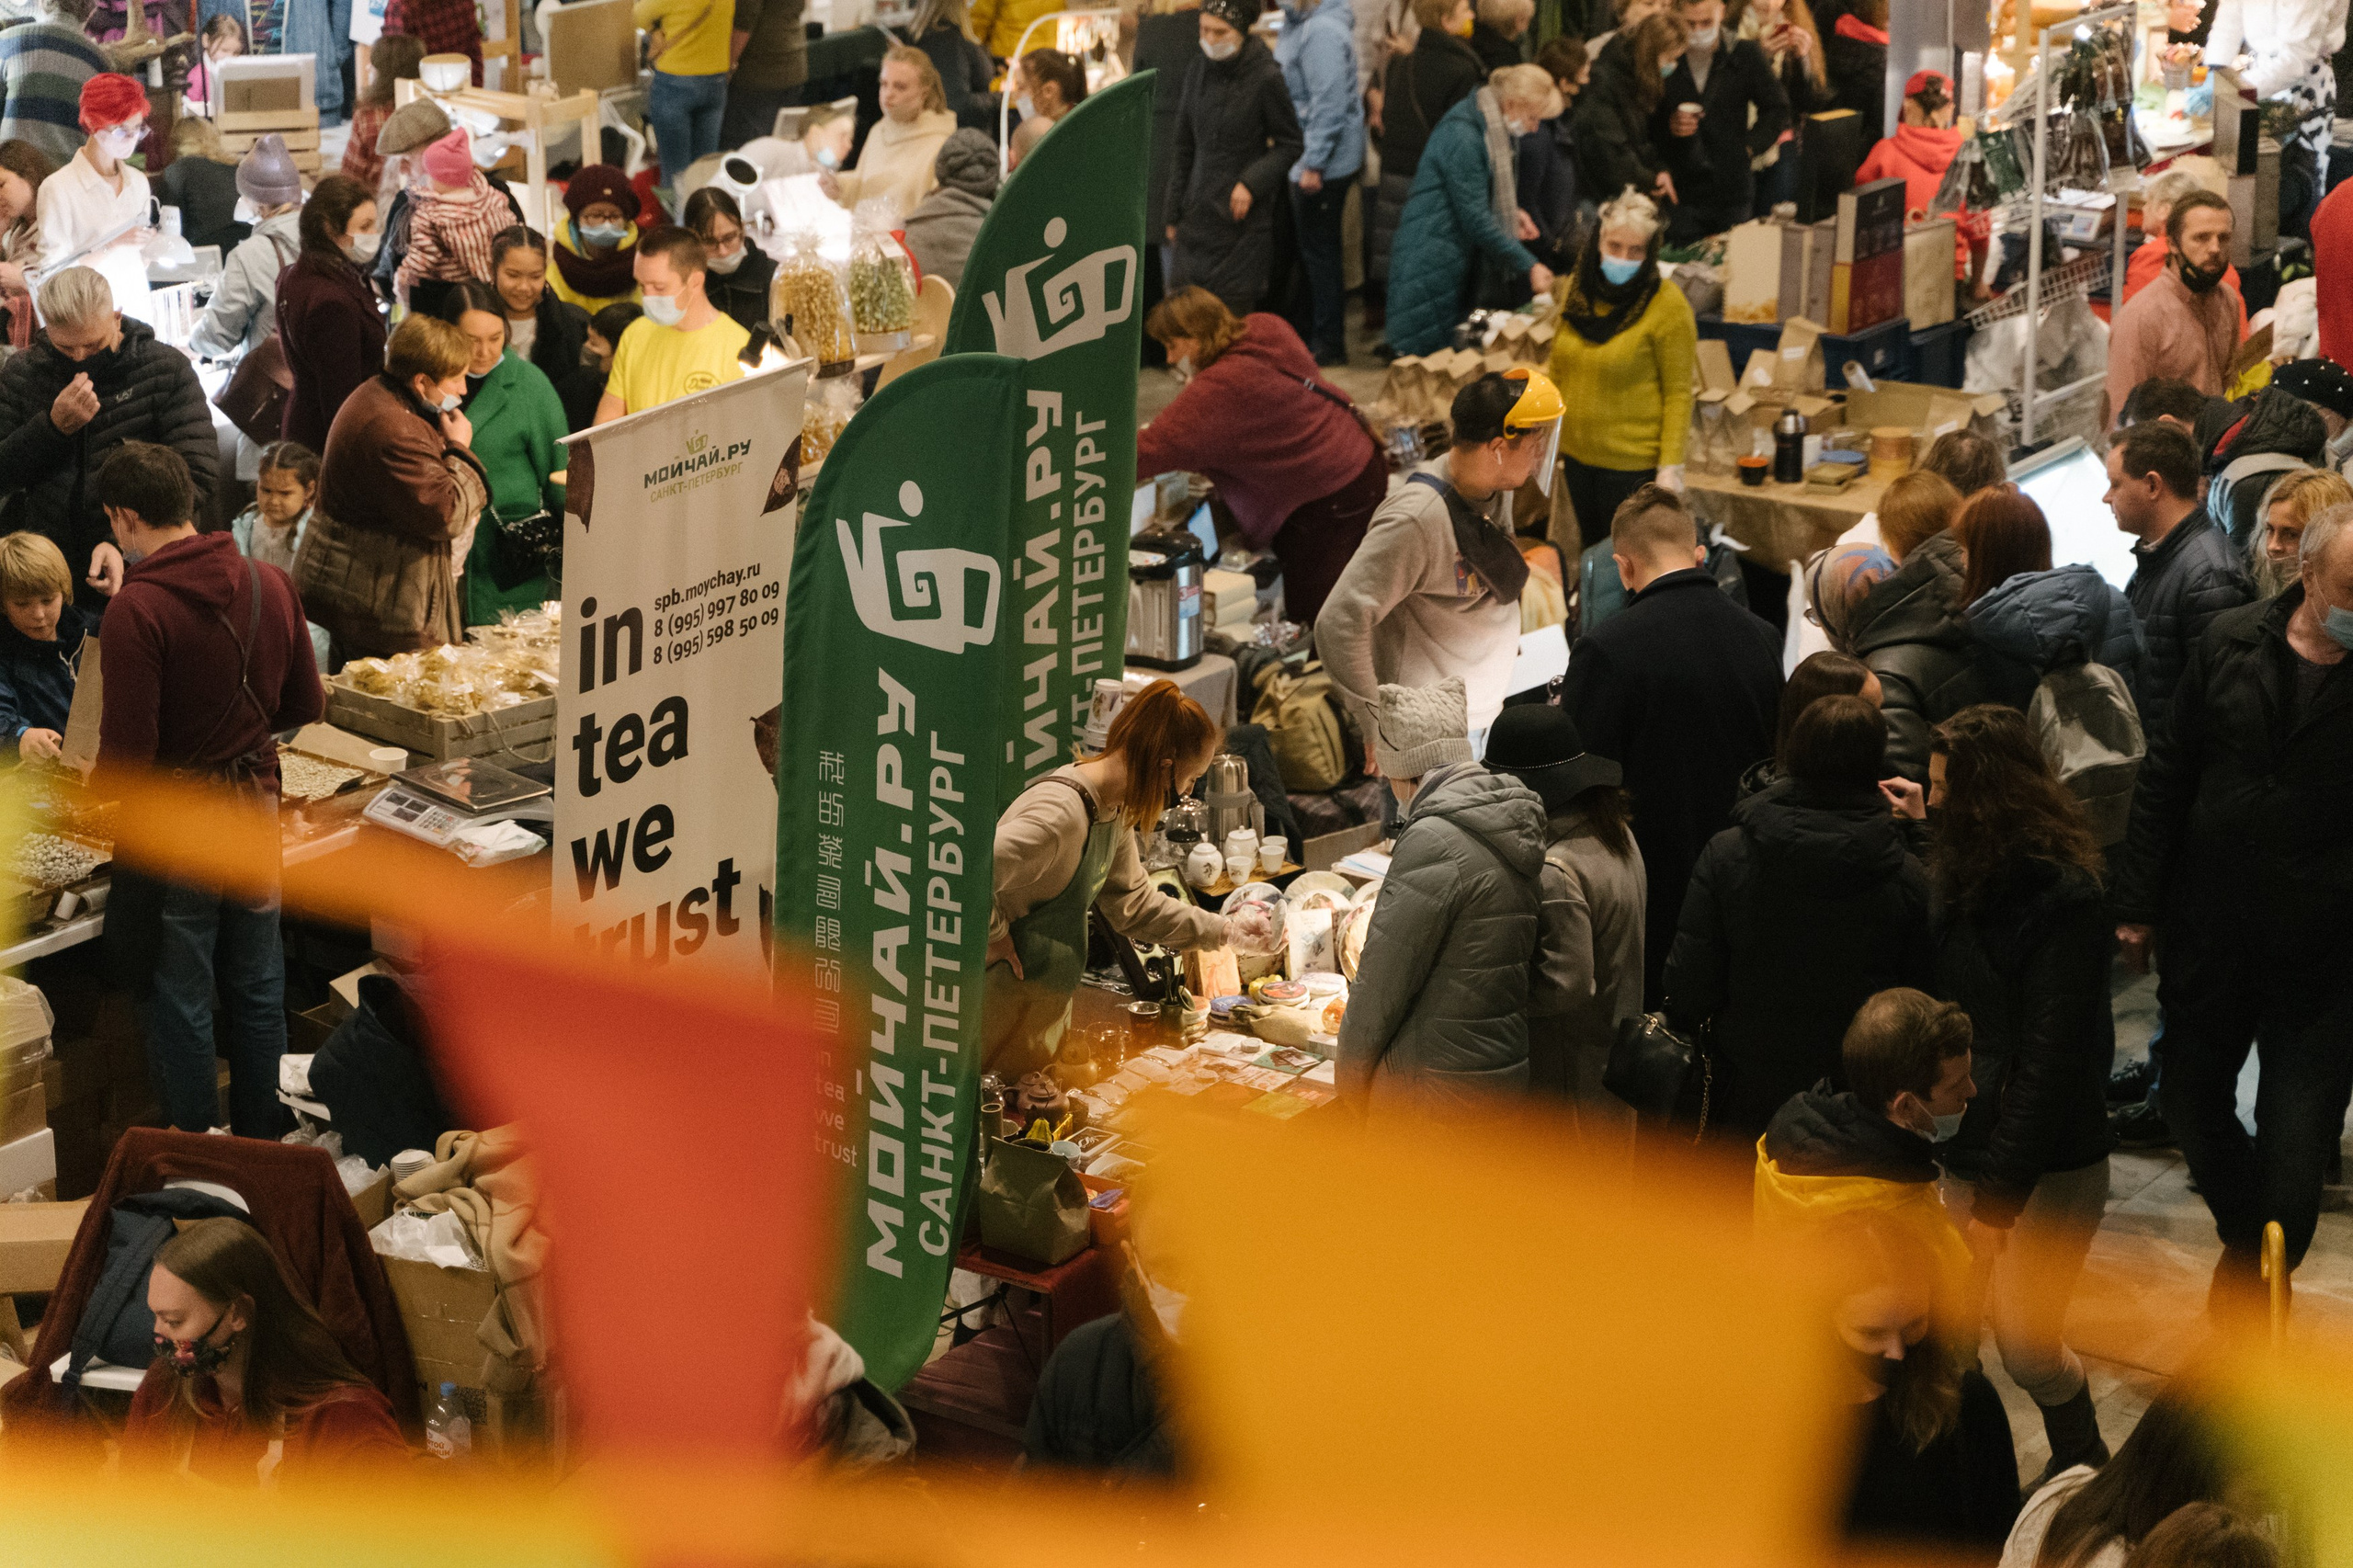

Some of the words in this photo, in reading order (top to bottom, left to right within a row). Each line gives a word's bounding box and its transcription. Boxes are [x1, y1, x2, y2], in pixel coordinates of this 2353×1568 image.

[644, 438, 752, 489] МОЙЧАЙ.РУ
[650, 461, 745, 503] САНКТ-ПЕТЕРБУРГ
[654, 562, 761, 613] spb.moychay.ru
[654, 619, 664, 637] 8
[668, 602, 705, 636] (995)
[707, 597, 736, 620] 997
[740, 588, 758, 607] 80
[762, 581, 780, 599] 09
[654, 646, 663, 665] 8
[667, 629, 703, 664] (995)
[706, 619, 734, 647] 598
[739, 615, 757, 637] 50
[761, 608, 779, 625] 09
[1006, 389, 1063, 789] ЙЧАЙ.РУ
[579, 597, 643, 695] in
[573, 696, 689, 798] tea
[571, 803, 675, 903] we
[856, 666, 916, 1278] МОЙЧАЙ.РУ
[918, 730, 965, 1256] САНКТ-ПЕТЕРБУРГ
